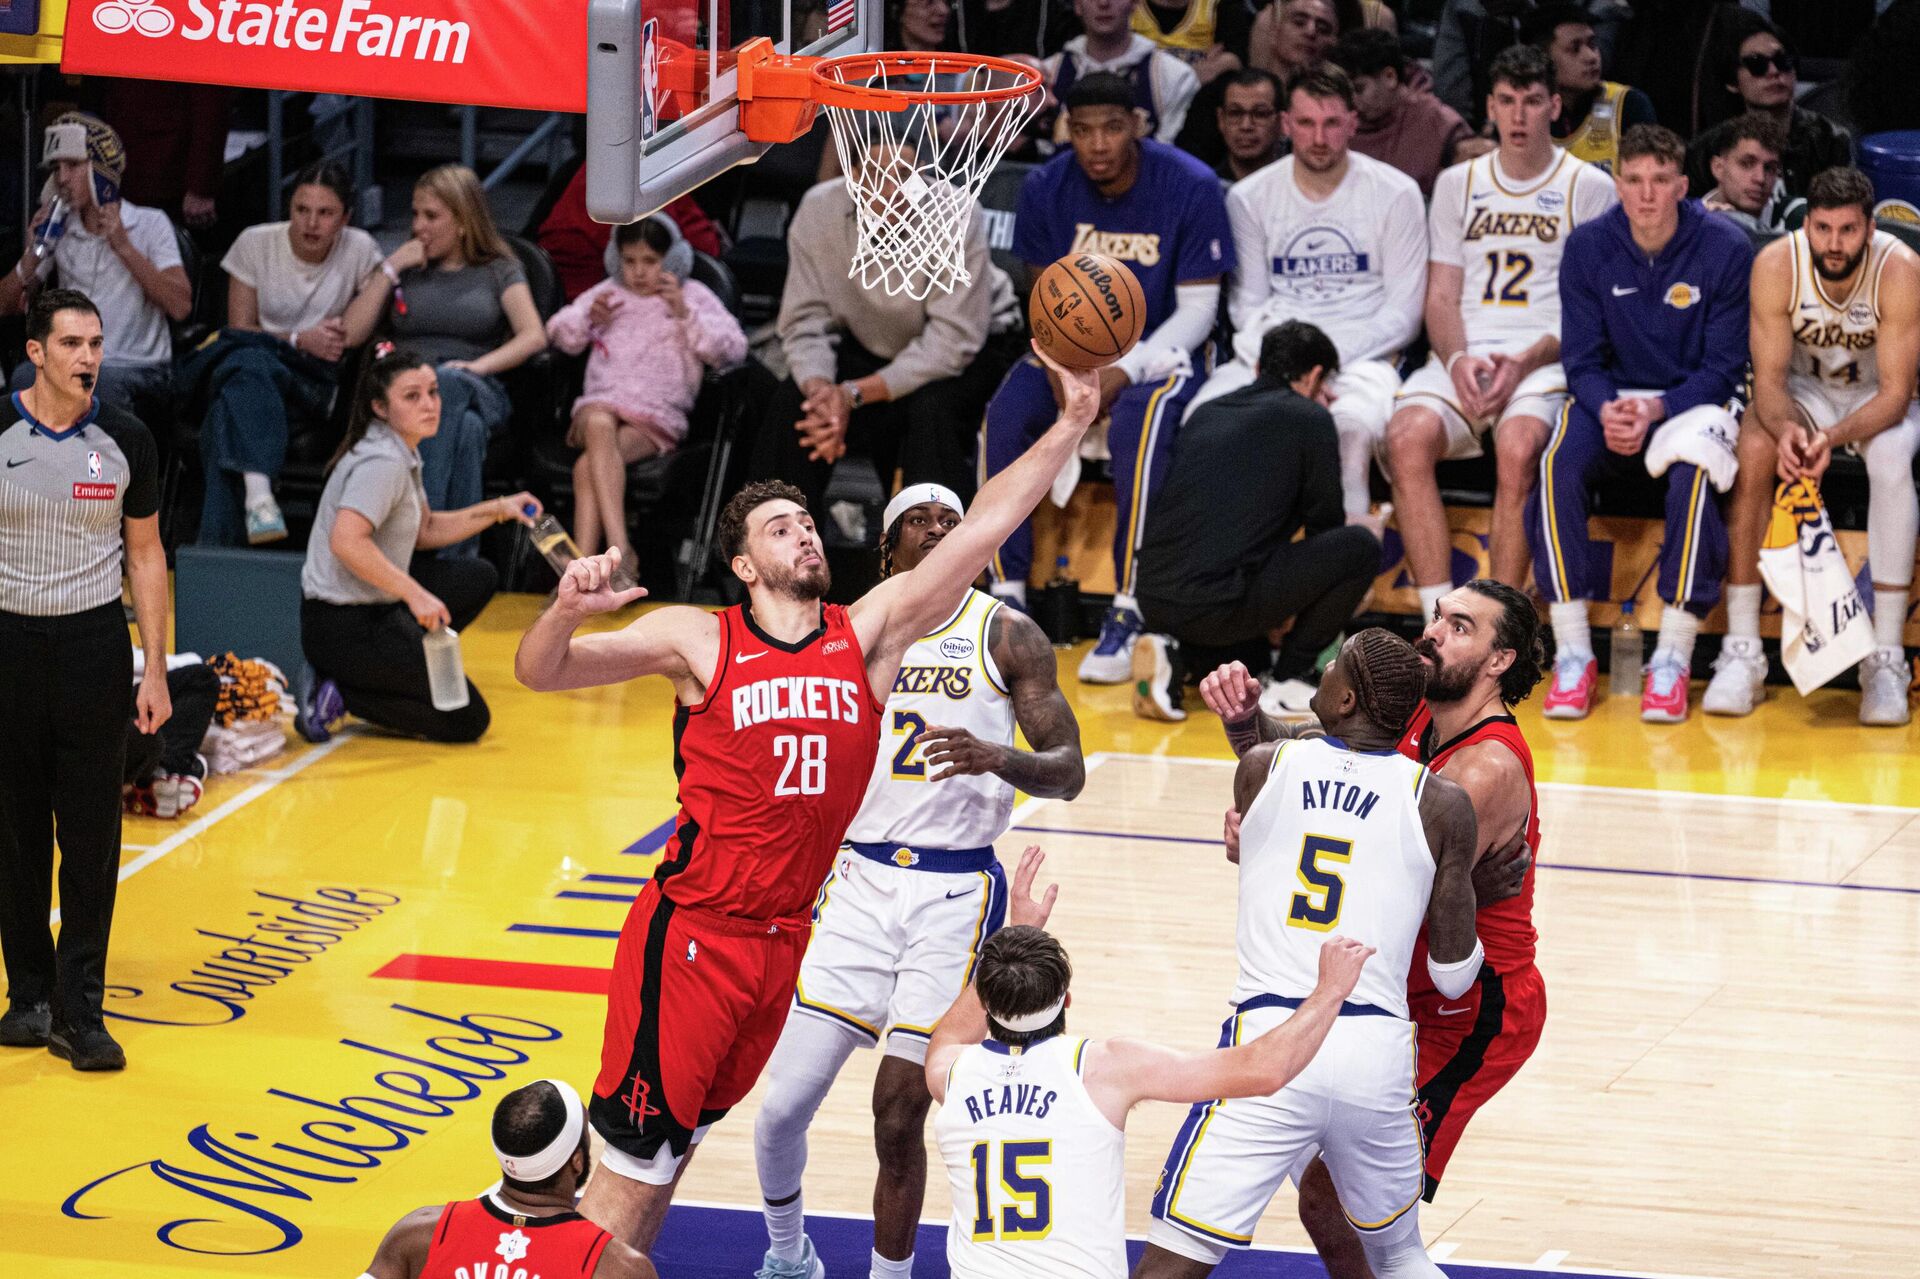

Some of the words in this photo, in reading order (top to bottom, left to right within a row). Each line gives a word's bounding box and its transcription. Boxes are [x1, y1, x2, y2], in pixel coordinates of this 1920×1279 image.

[1069, 223, 1161, 267] LAKERS
[1463, 206, 1560, 243] LAKERS
[1074, 256, 1123, 322] Wilson
[1481, 250, 1534, 306] 12
[1810, 355, 1861, 385] 14
[74, 484, 115, 498] Emirates
[943, 642, 972, 653] bibigo
[731, 676, 859, 732] ROCKETS
[891, 665, 973, 700] KERS
[773, 734, 828, 797] 28
[890, 709, 928, 782] 2
[1302, 780, 1380, 820] AYTON
[1286, 832, 1355, 933] 5
[101, 887, 401, 1027] Courtside
[61, 1003, 563, 1256] Michelob
[965, 1084, 1058, 1124] REAVES
[970, 1138, 1053, 1242] 15
